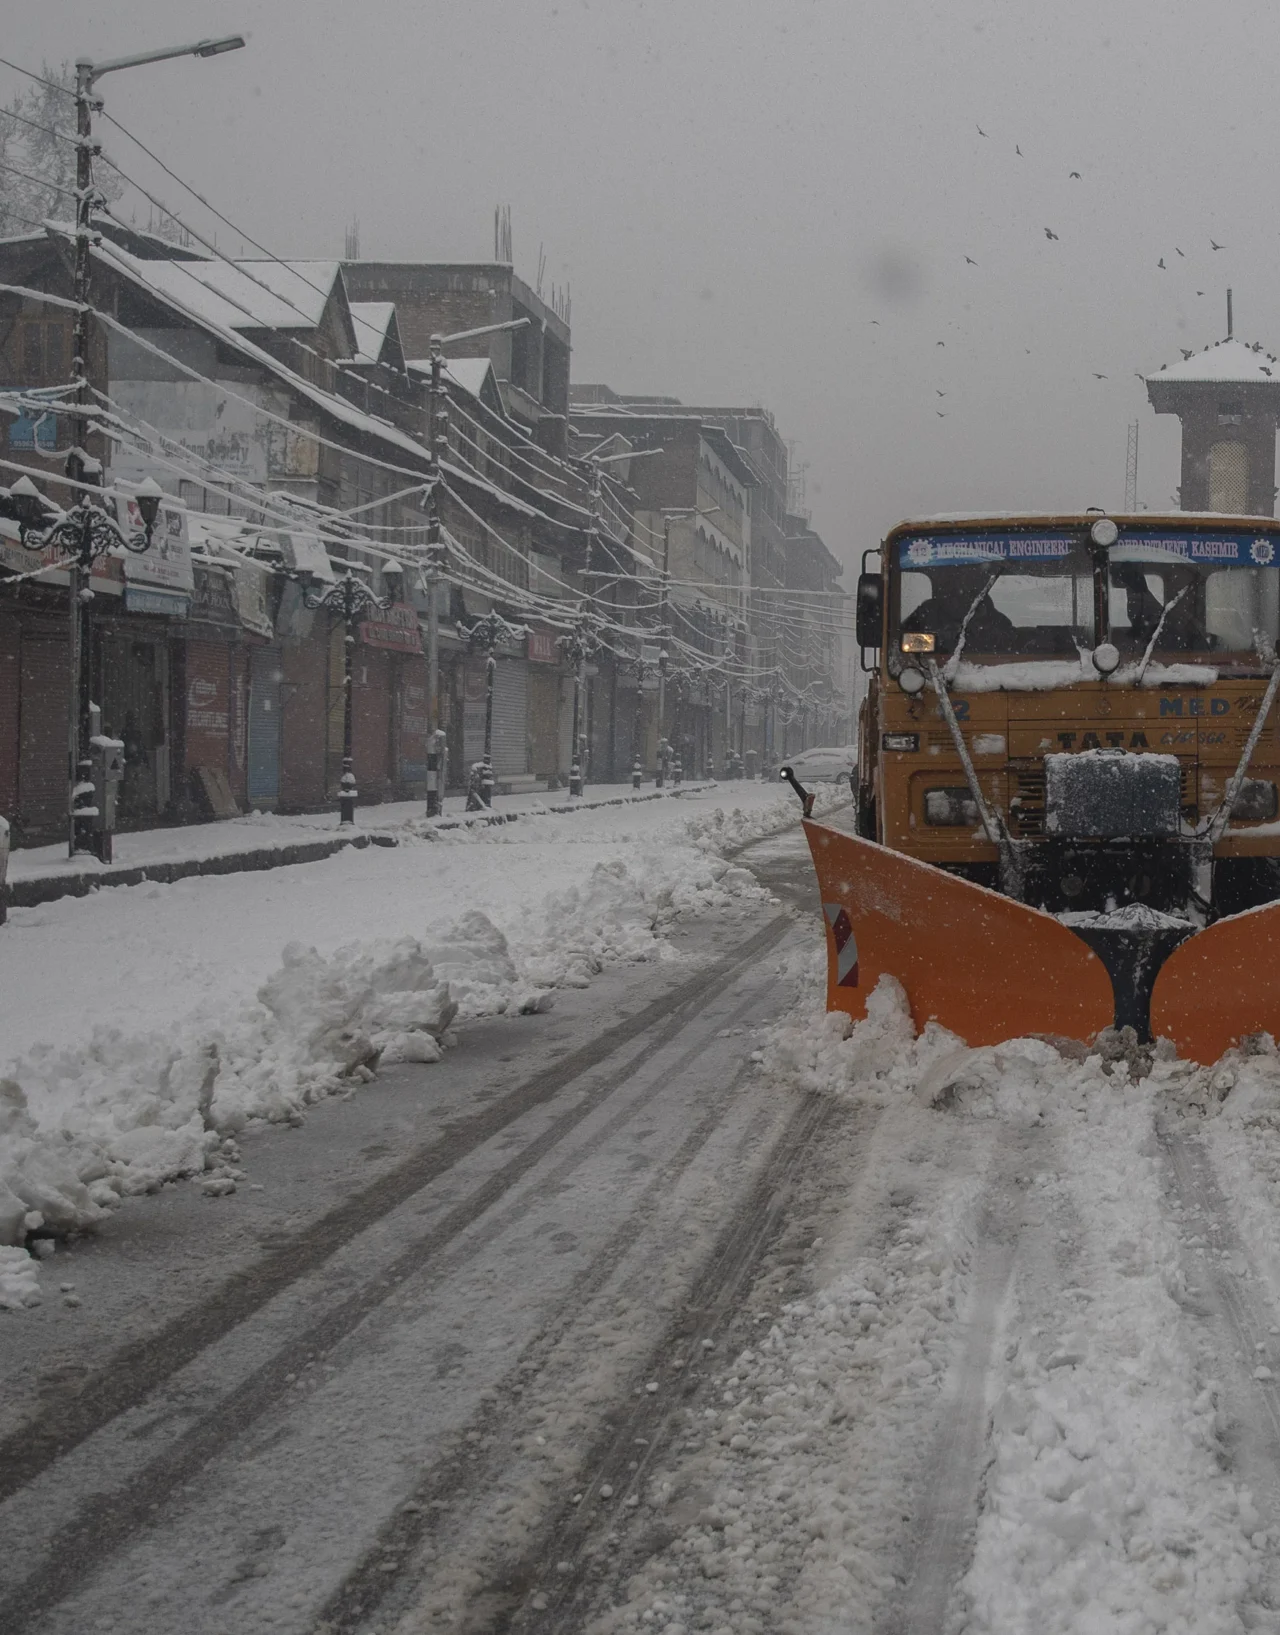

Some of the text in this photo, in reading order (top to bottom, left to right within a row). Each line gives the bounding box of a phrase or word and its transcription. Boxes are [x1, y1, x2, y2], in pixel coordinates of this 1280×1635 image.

[937, 542, 1007, 558] MECHANICAL
[1192, 541, 1238, 558] KASHMIR
[1057, 731, 1149, 749] TATA
